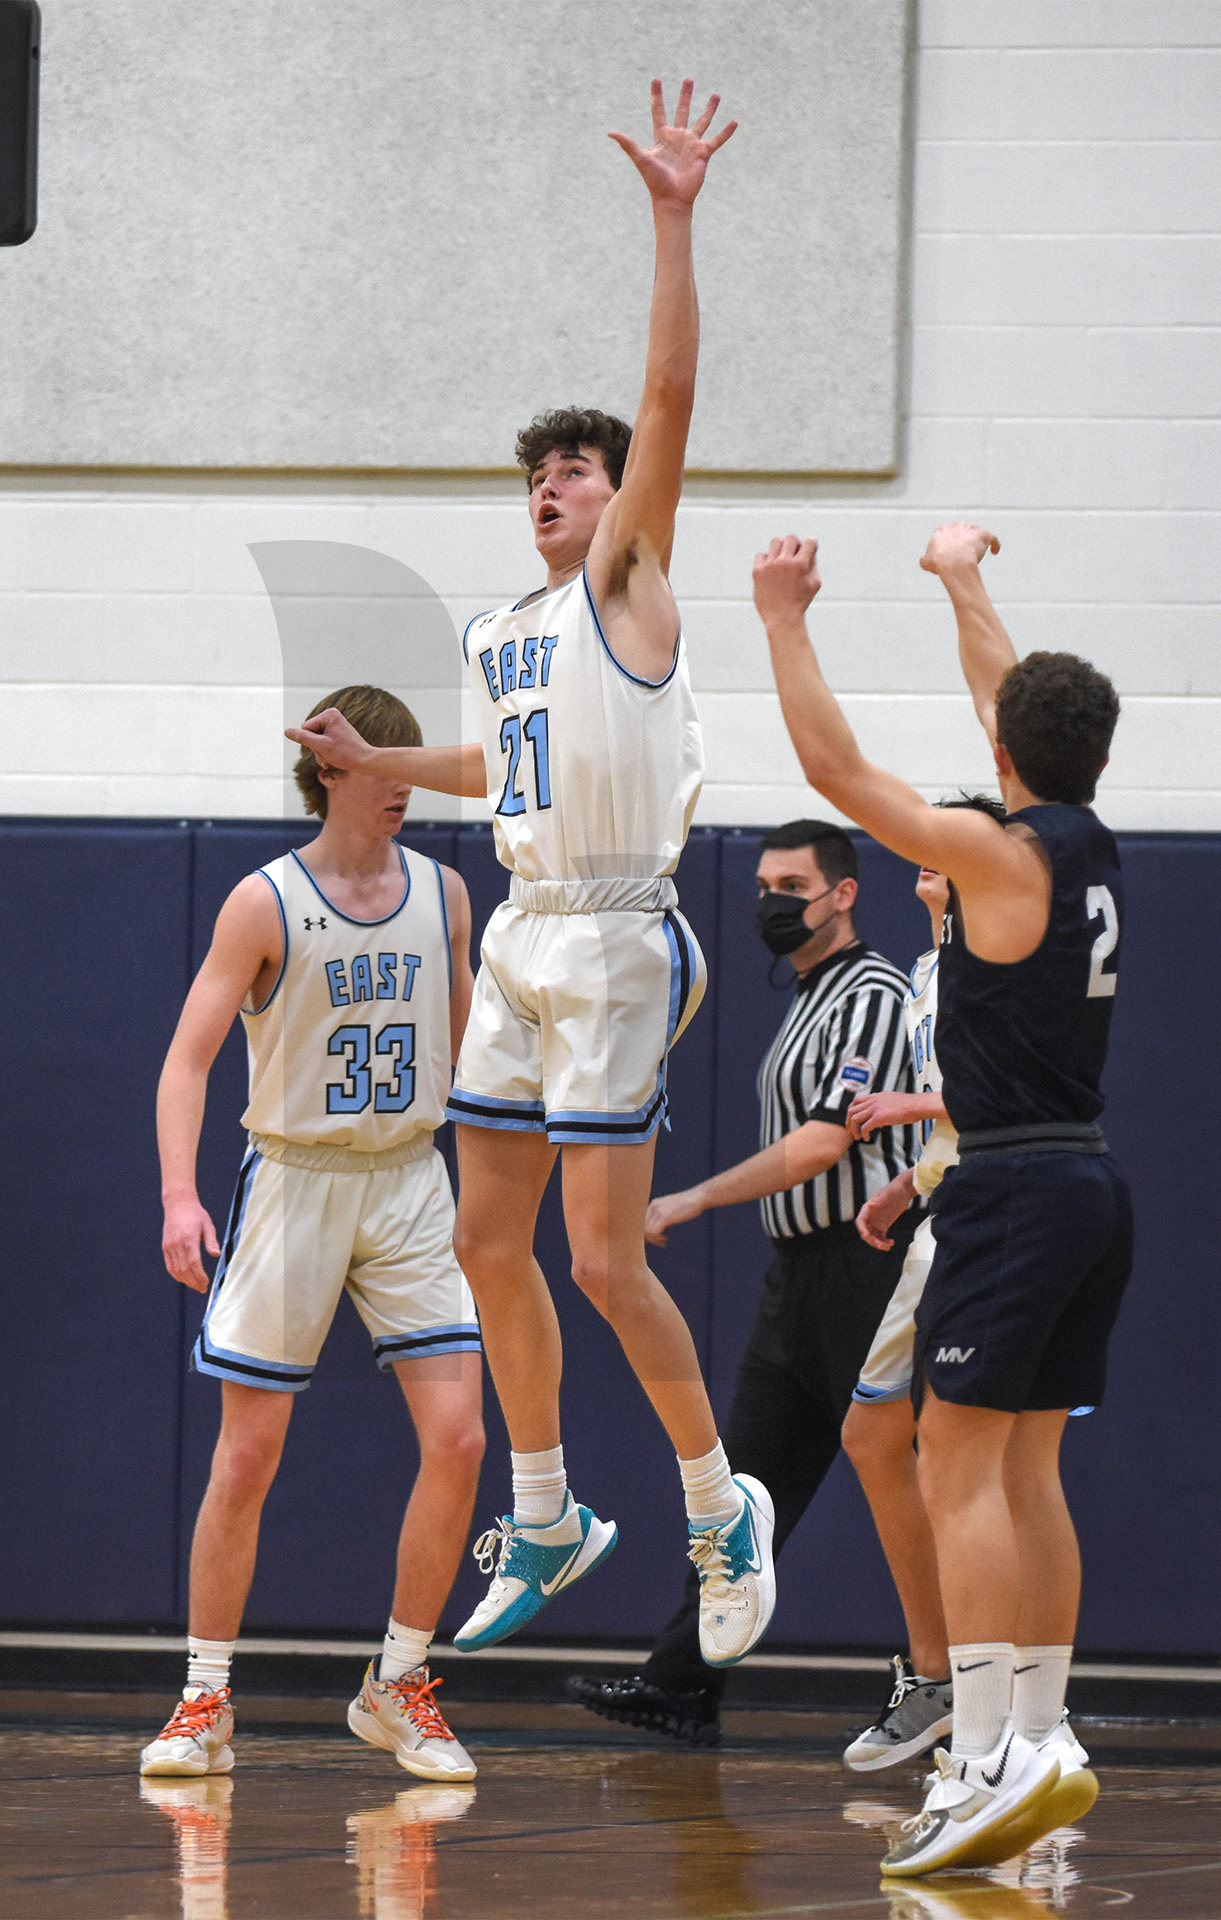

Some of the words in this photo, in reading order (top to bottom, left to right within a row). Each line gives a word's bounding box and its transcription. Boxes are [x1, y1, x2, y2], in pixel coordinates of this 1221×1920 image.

[478, 634, 560, 703] EAST
[494, 707, 552, 817] 21
[325, 952, 422, 1007] EAST
[1086, 885, 1119, 998] 2
[326, 1022, 416, 1115] 33
[935, 1347, 976, 1364] MV
